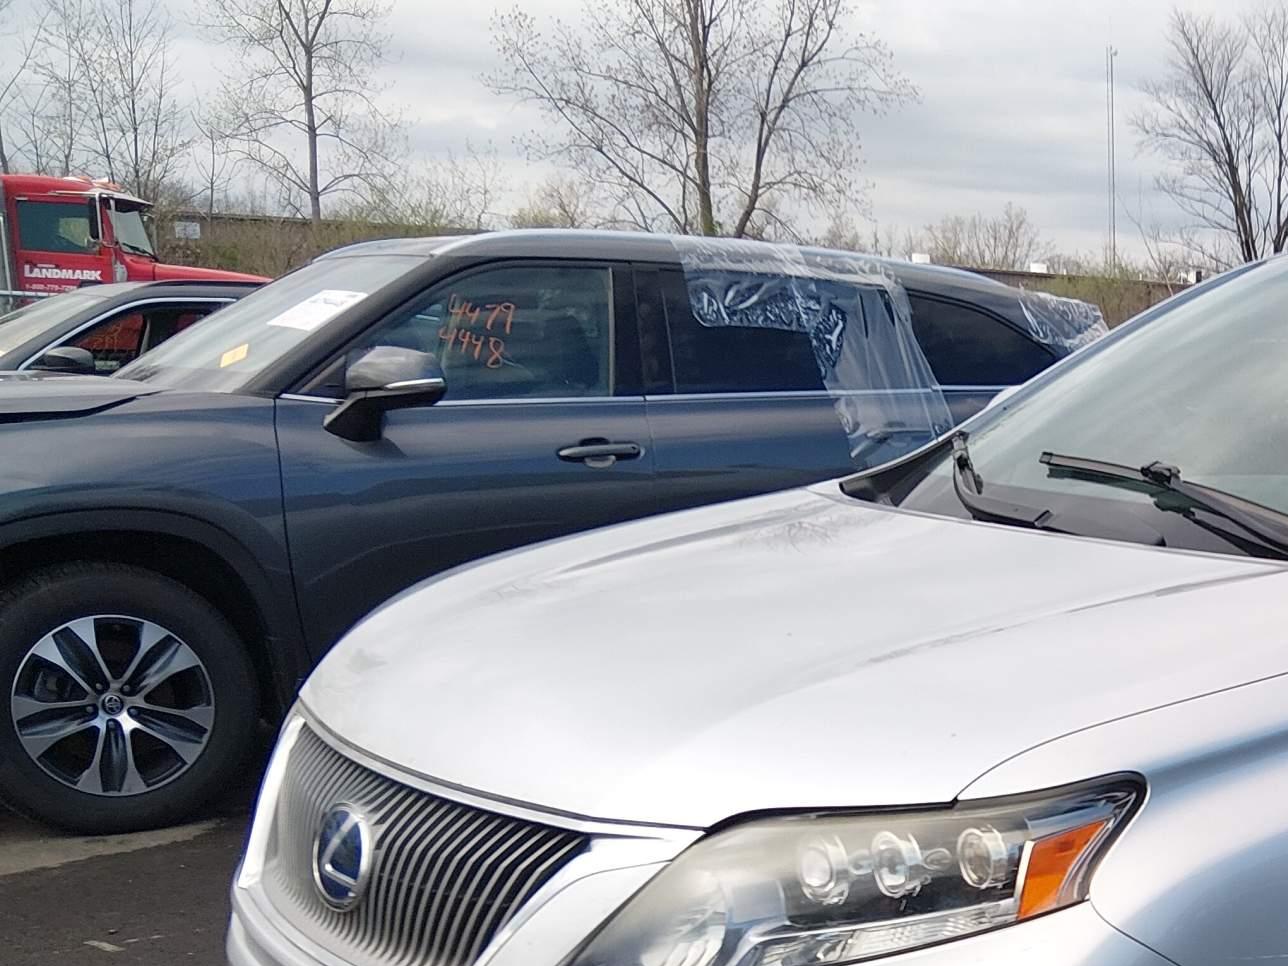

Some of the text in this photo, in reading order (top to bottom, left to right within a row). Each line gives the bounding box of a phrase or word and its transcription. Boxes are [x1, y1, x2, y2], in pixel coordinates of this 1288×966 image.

[24, 264, 102, 280] LANDMARK
[449, 294, 515, 334] 4479
[438, 326, 506, 369] 4448
